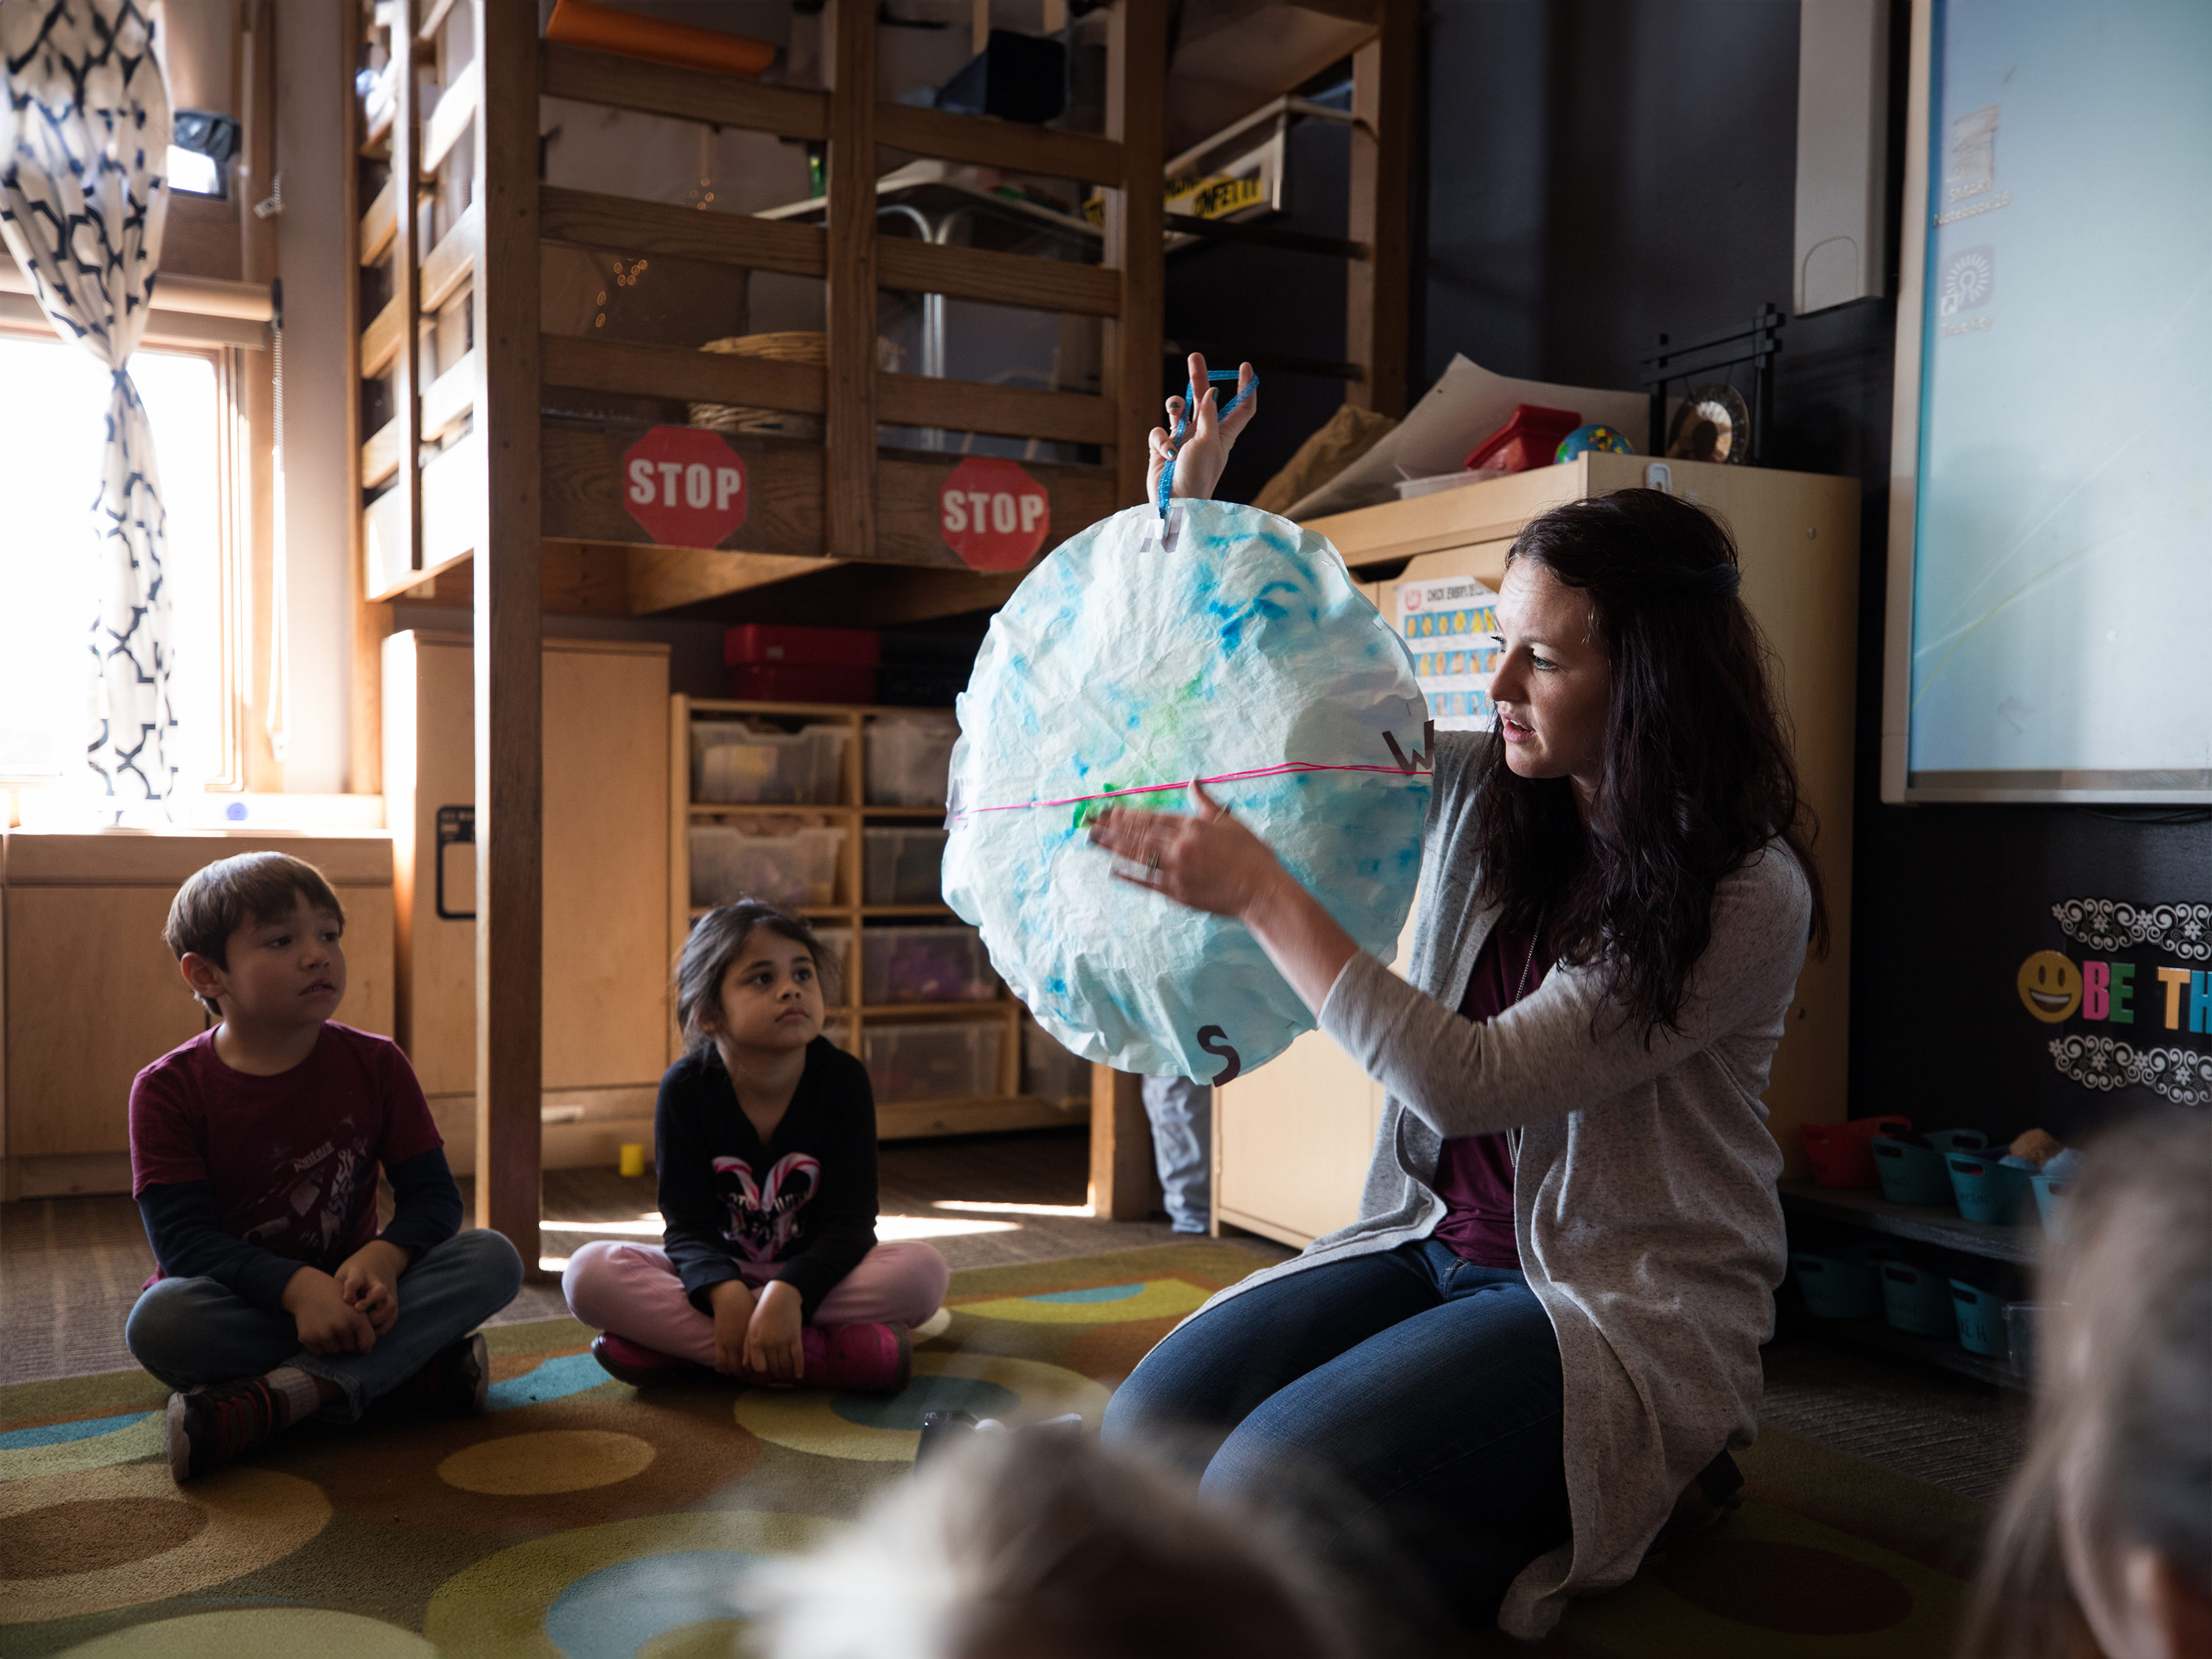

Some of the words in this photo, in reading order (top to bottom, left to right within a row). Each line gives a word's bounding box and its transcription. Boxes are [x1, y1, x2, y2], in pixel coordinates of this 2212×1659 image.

[629, 458, 741, 510] STOP
[943, 490, 1044, 534] STOP
[1382, 719, 1435, 776] W
[2082, 960, 2136, 1024] BE
[2156, 966, 2212, 1034] TH
[1197, 1024, 1241, 1088] S
